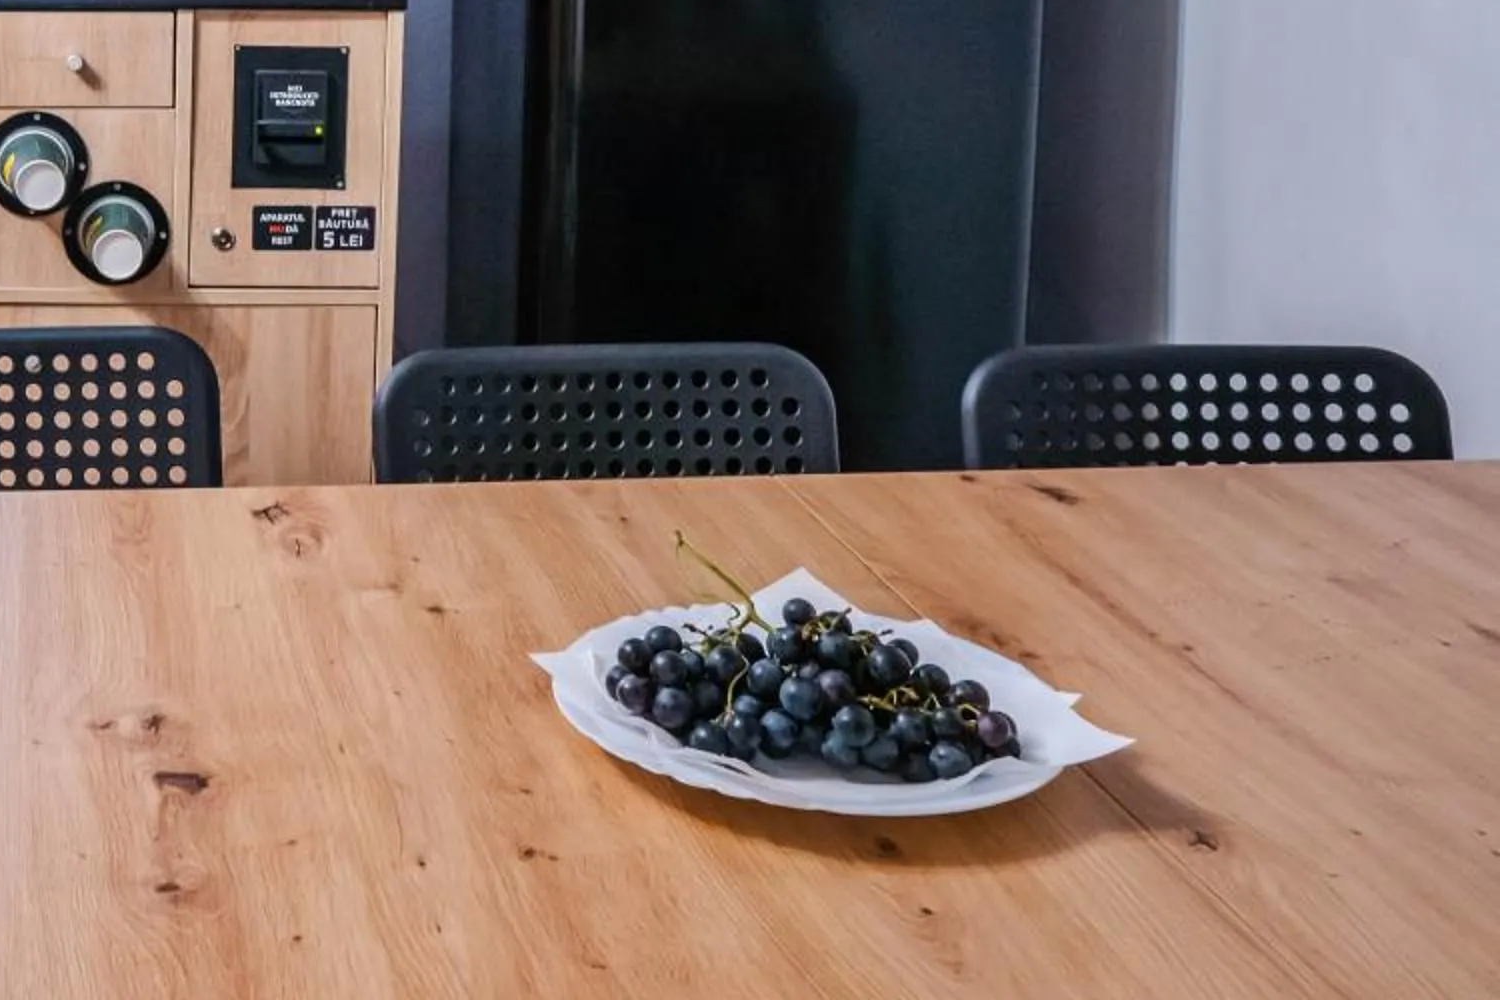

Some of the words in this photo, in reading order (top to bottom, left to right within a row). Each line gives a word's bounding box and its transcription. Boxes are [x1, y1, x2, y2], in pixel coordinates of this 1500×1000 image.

[259, 213, 306, 222] APARATUL
[323, 231, 335, 248] 5
[341, 234, 363, 248] LEI
